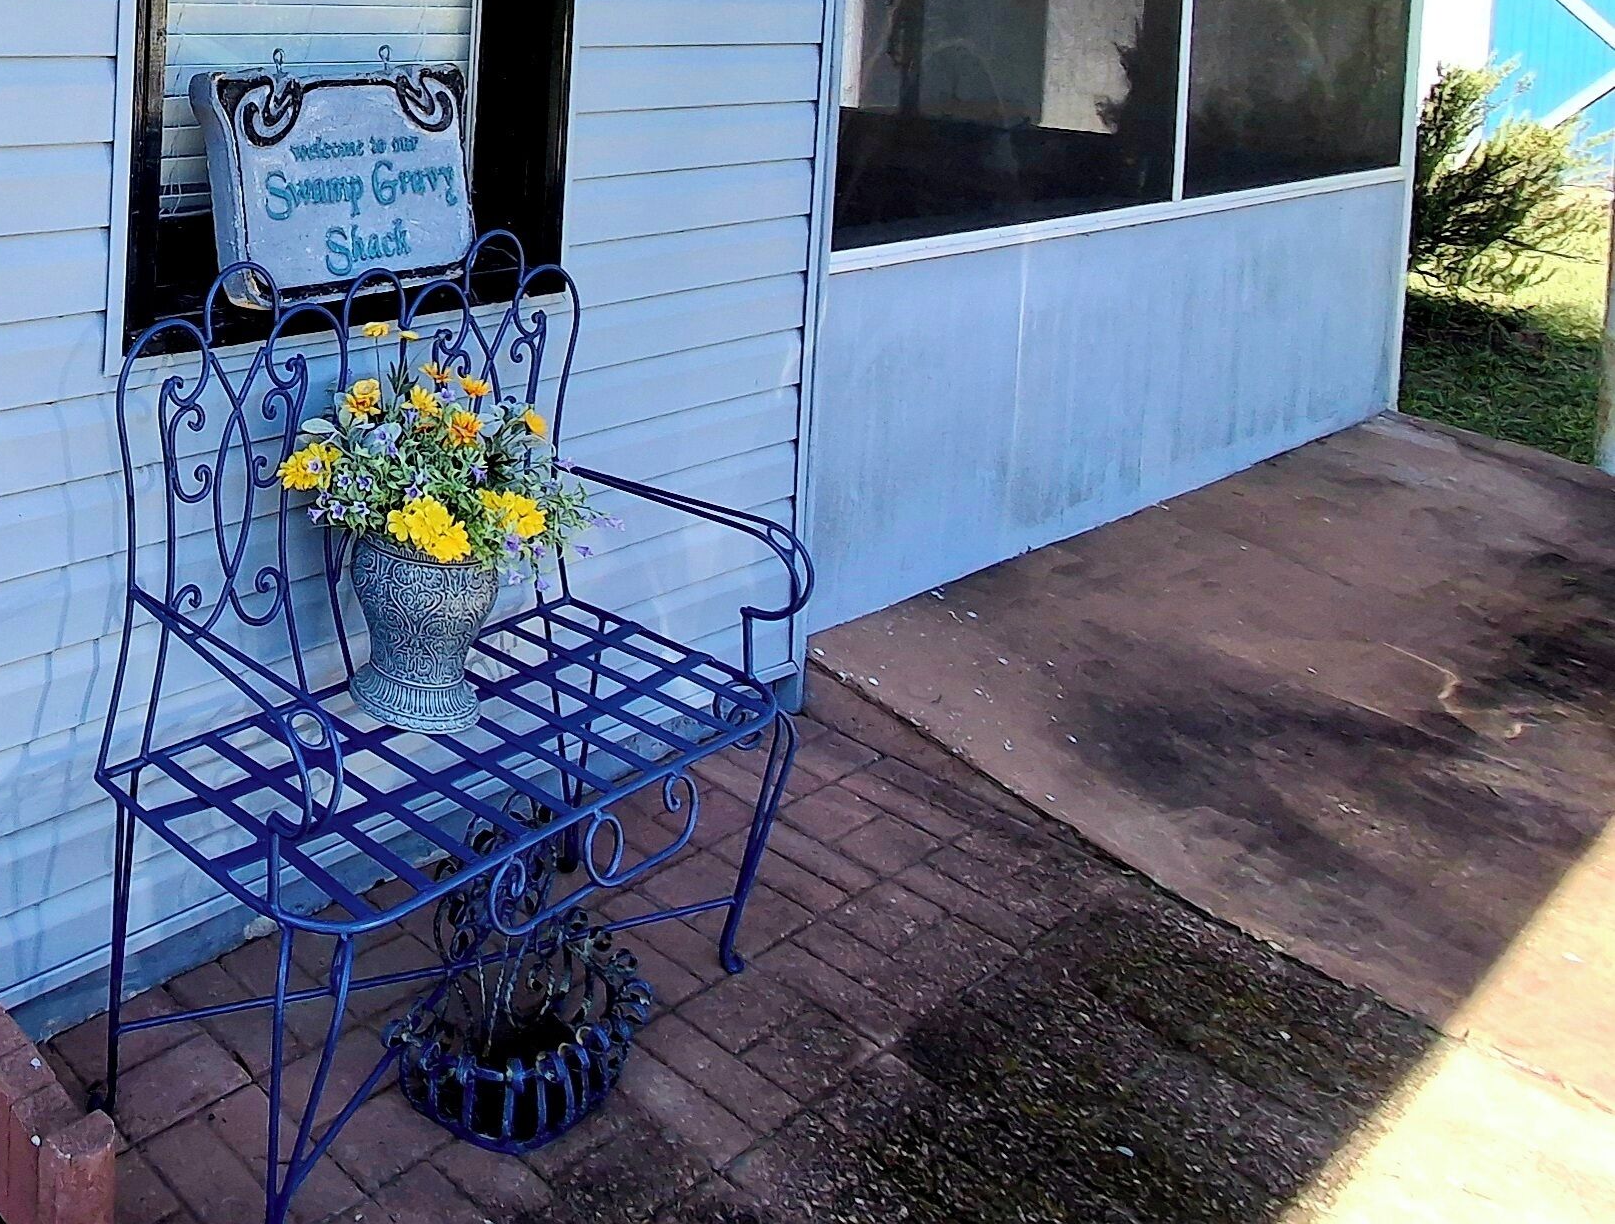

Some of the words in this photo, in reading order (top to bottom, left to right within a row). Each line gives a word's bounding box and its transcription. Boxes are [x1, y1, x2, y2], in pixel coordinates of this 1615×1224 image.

[290, 137, 365, 162] welcome
[369, 135, 387, 154] to
[391, 135, 420, 153] our
[265, 170, 364, 221] Swamp
[371, 160, 459, 207] Gravy
[325, 218, 412, 276] Shack
